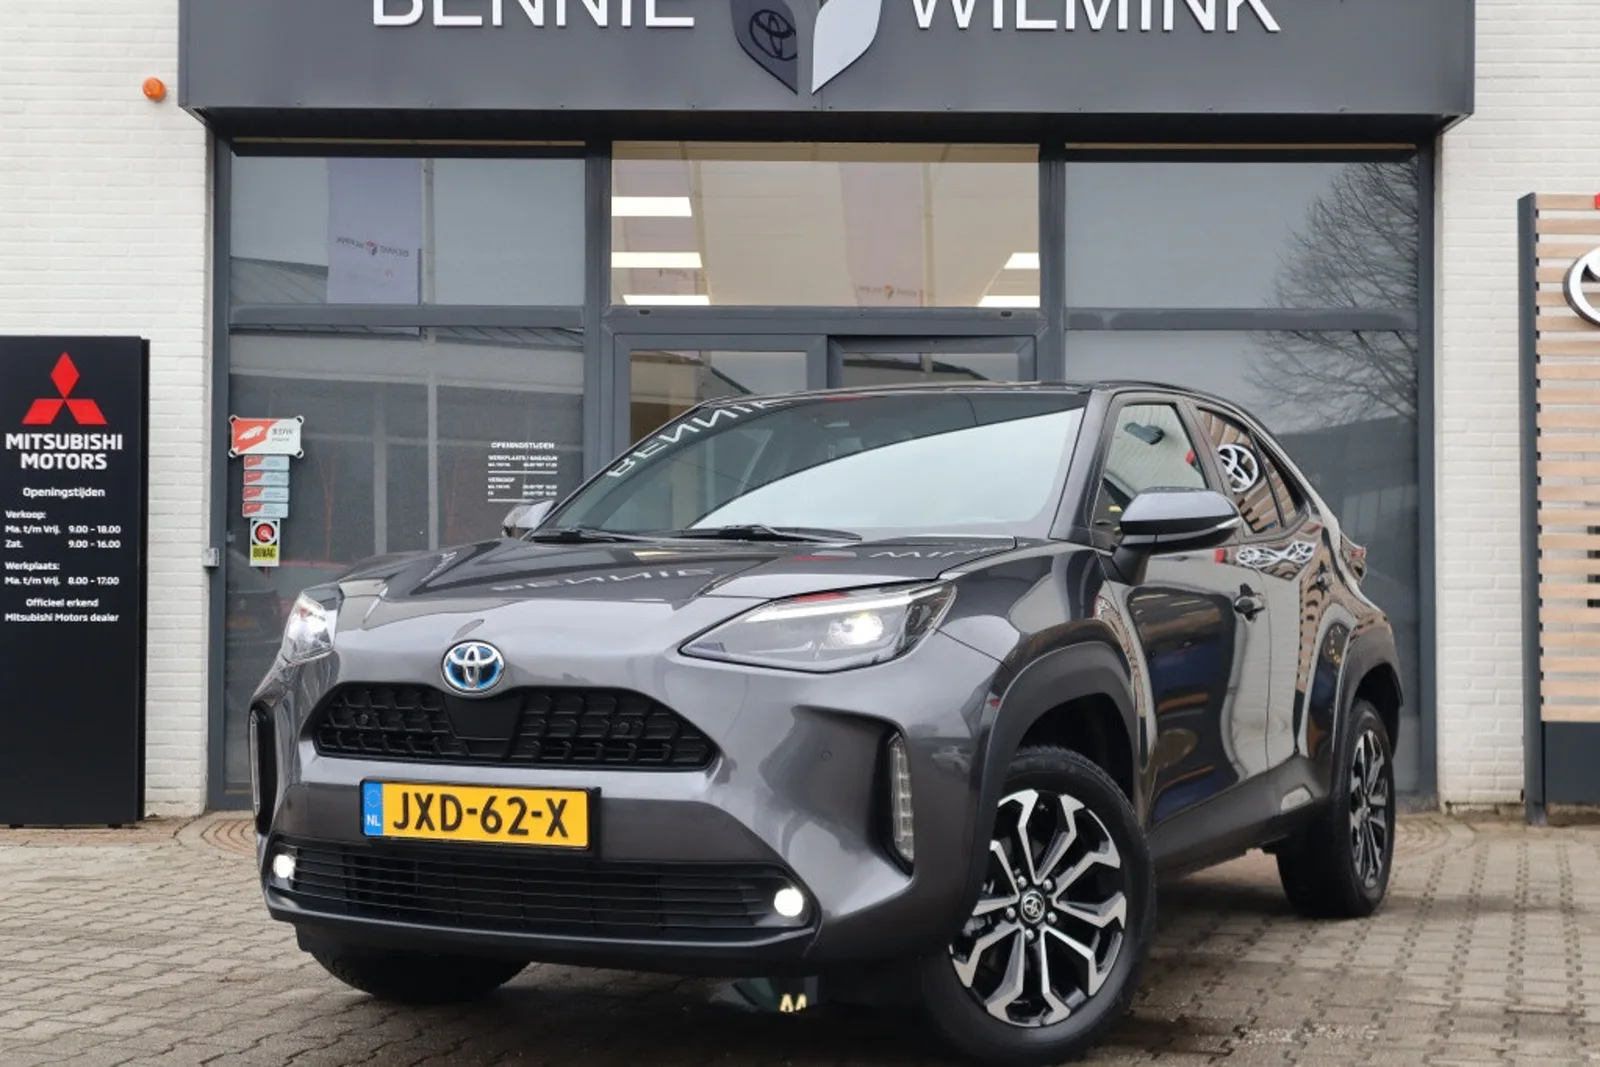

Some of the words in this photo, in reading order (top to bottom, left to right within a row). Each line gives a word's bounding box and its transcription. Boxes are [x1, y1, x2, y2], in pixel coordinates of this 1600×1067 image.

[5, 433, 123, 450] MITSUBISHI
[21, 452, 108, 470] MOTORS
[23, 487, 105, 499] Openingstijden
[5, 510, 46, 520] Verkoop:
[23, 525, 42, 534] t/m
[68, 525, 88, 533] 9.00
[97, 525, 121, 534] 18.00
[68, 540, 88, 548] 9.00
[97, 540, 121, 548] 16.00
[5, 561, 60, 571] Werkplaats:
[23, 576, 41, 585] t/m
[68, 577, 88, 585] 8.00
[66, 598, 99, 607] erkend
[5, 613, 53, 622] Mitsubishi
[55, 613, 88, 622] Motors
[90, 613, 119, 622] dealer
[366, 814, 381, 827] NL
[393, 792, 569, 838] JXD-62-X
